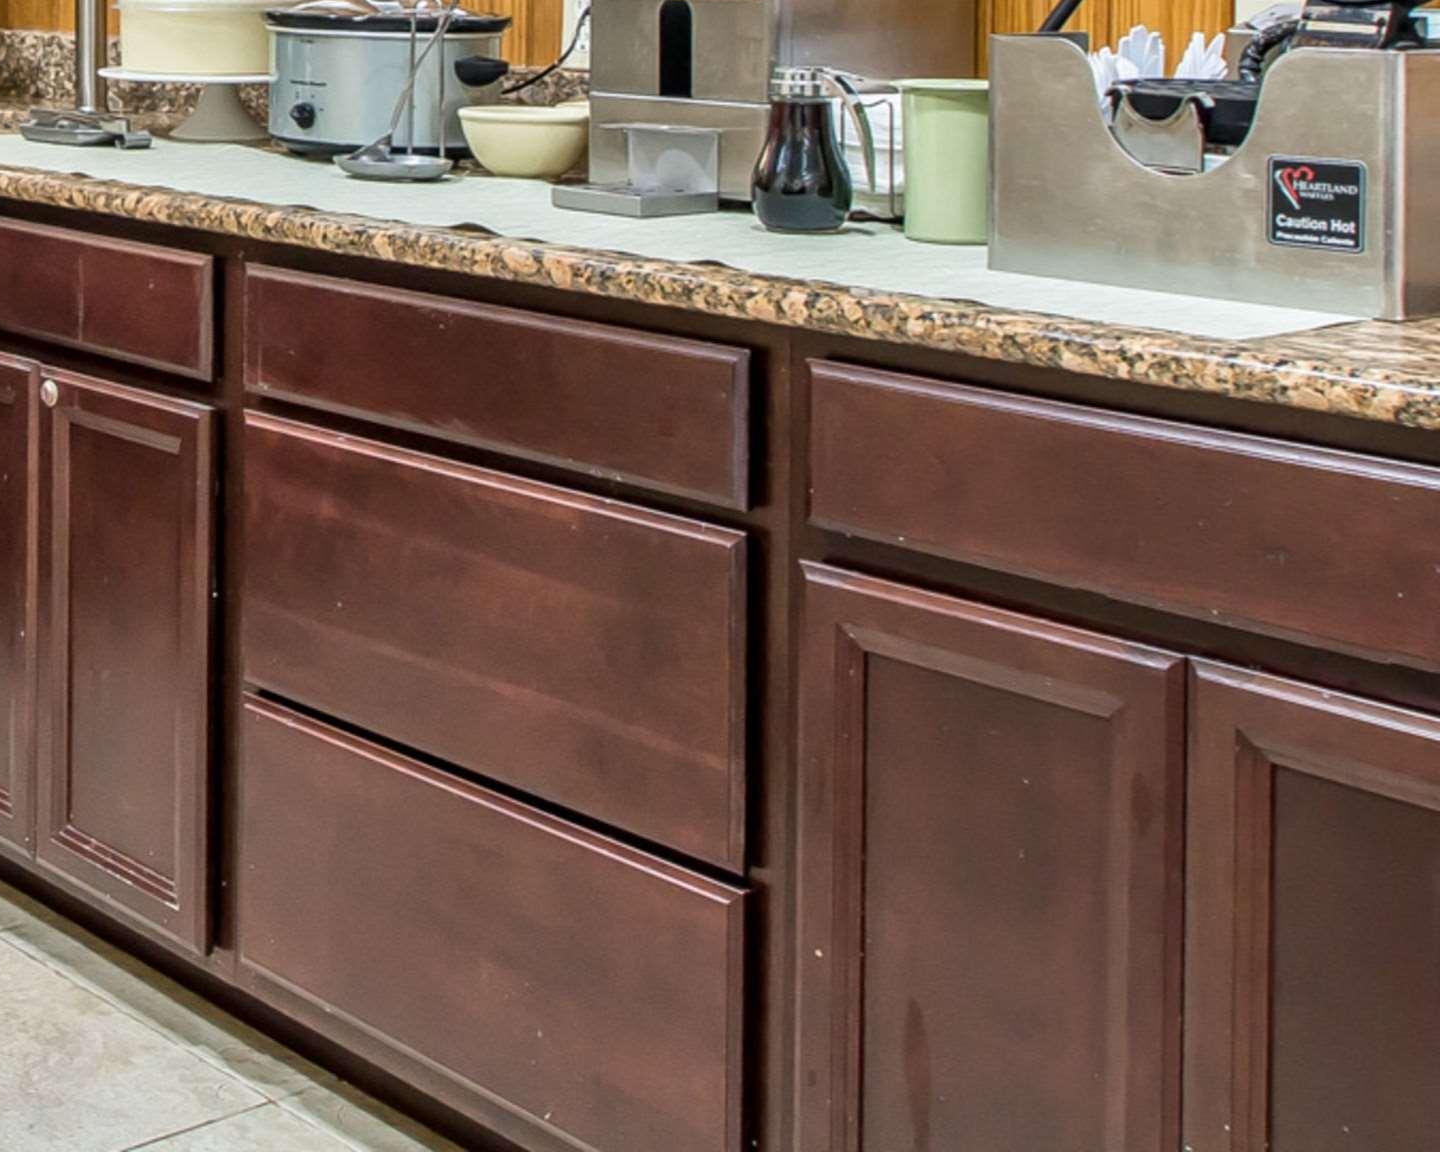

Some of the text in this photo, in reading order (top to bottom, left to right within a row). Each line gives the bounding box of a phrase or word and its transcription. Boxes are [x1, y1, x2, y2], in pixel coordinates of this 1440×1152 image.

[1292, 179, 1358, 195] HEARTLAND
[1275, 213, 1357, 235] Caution Hot
